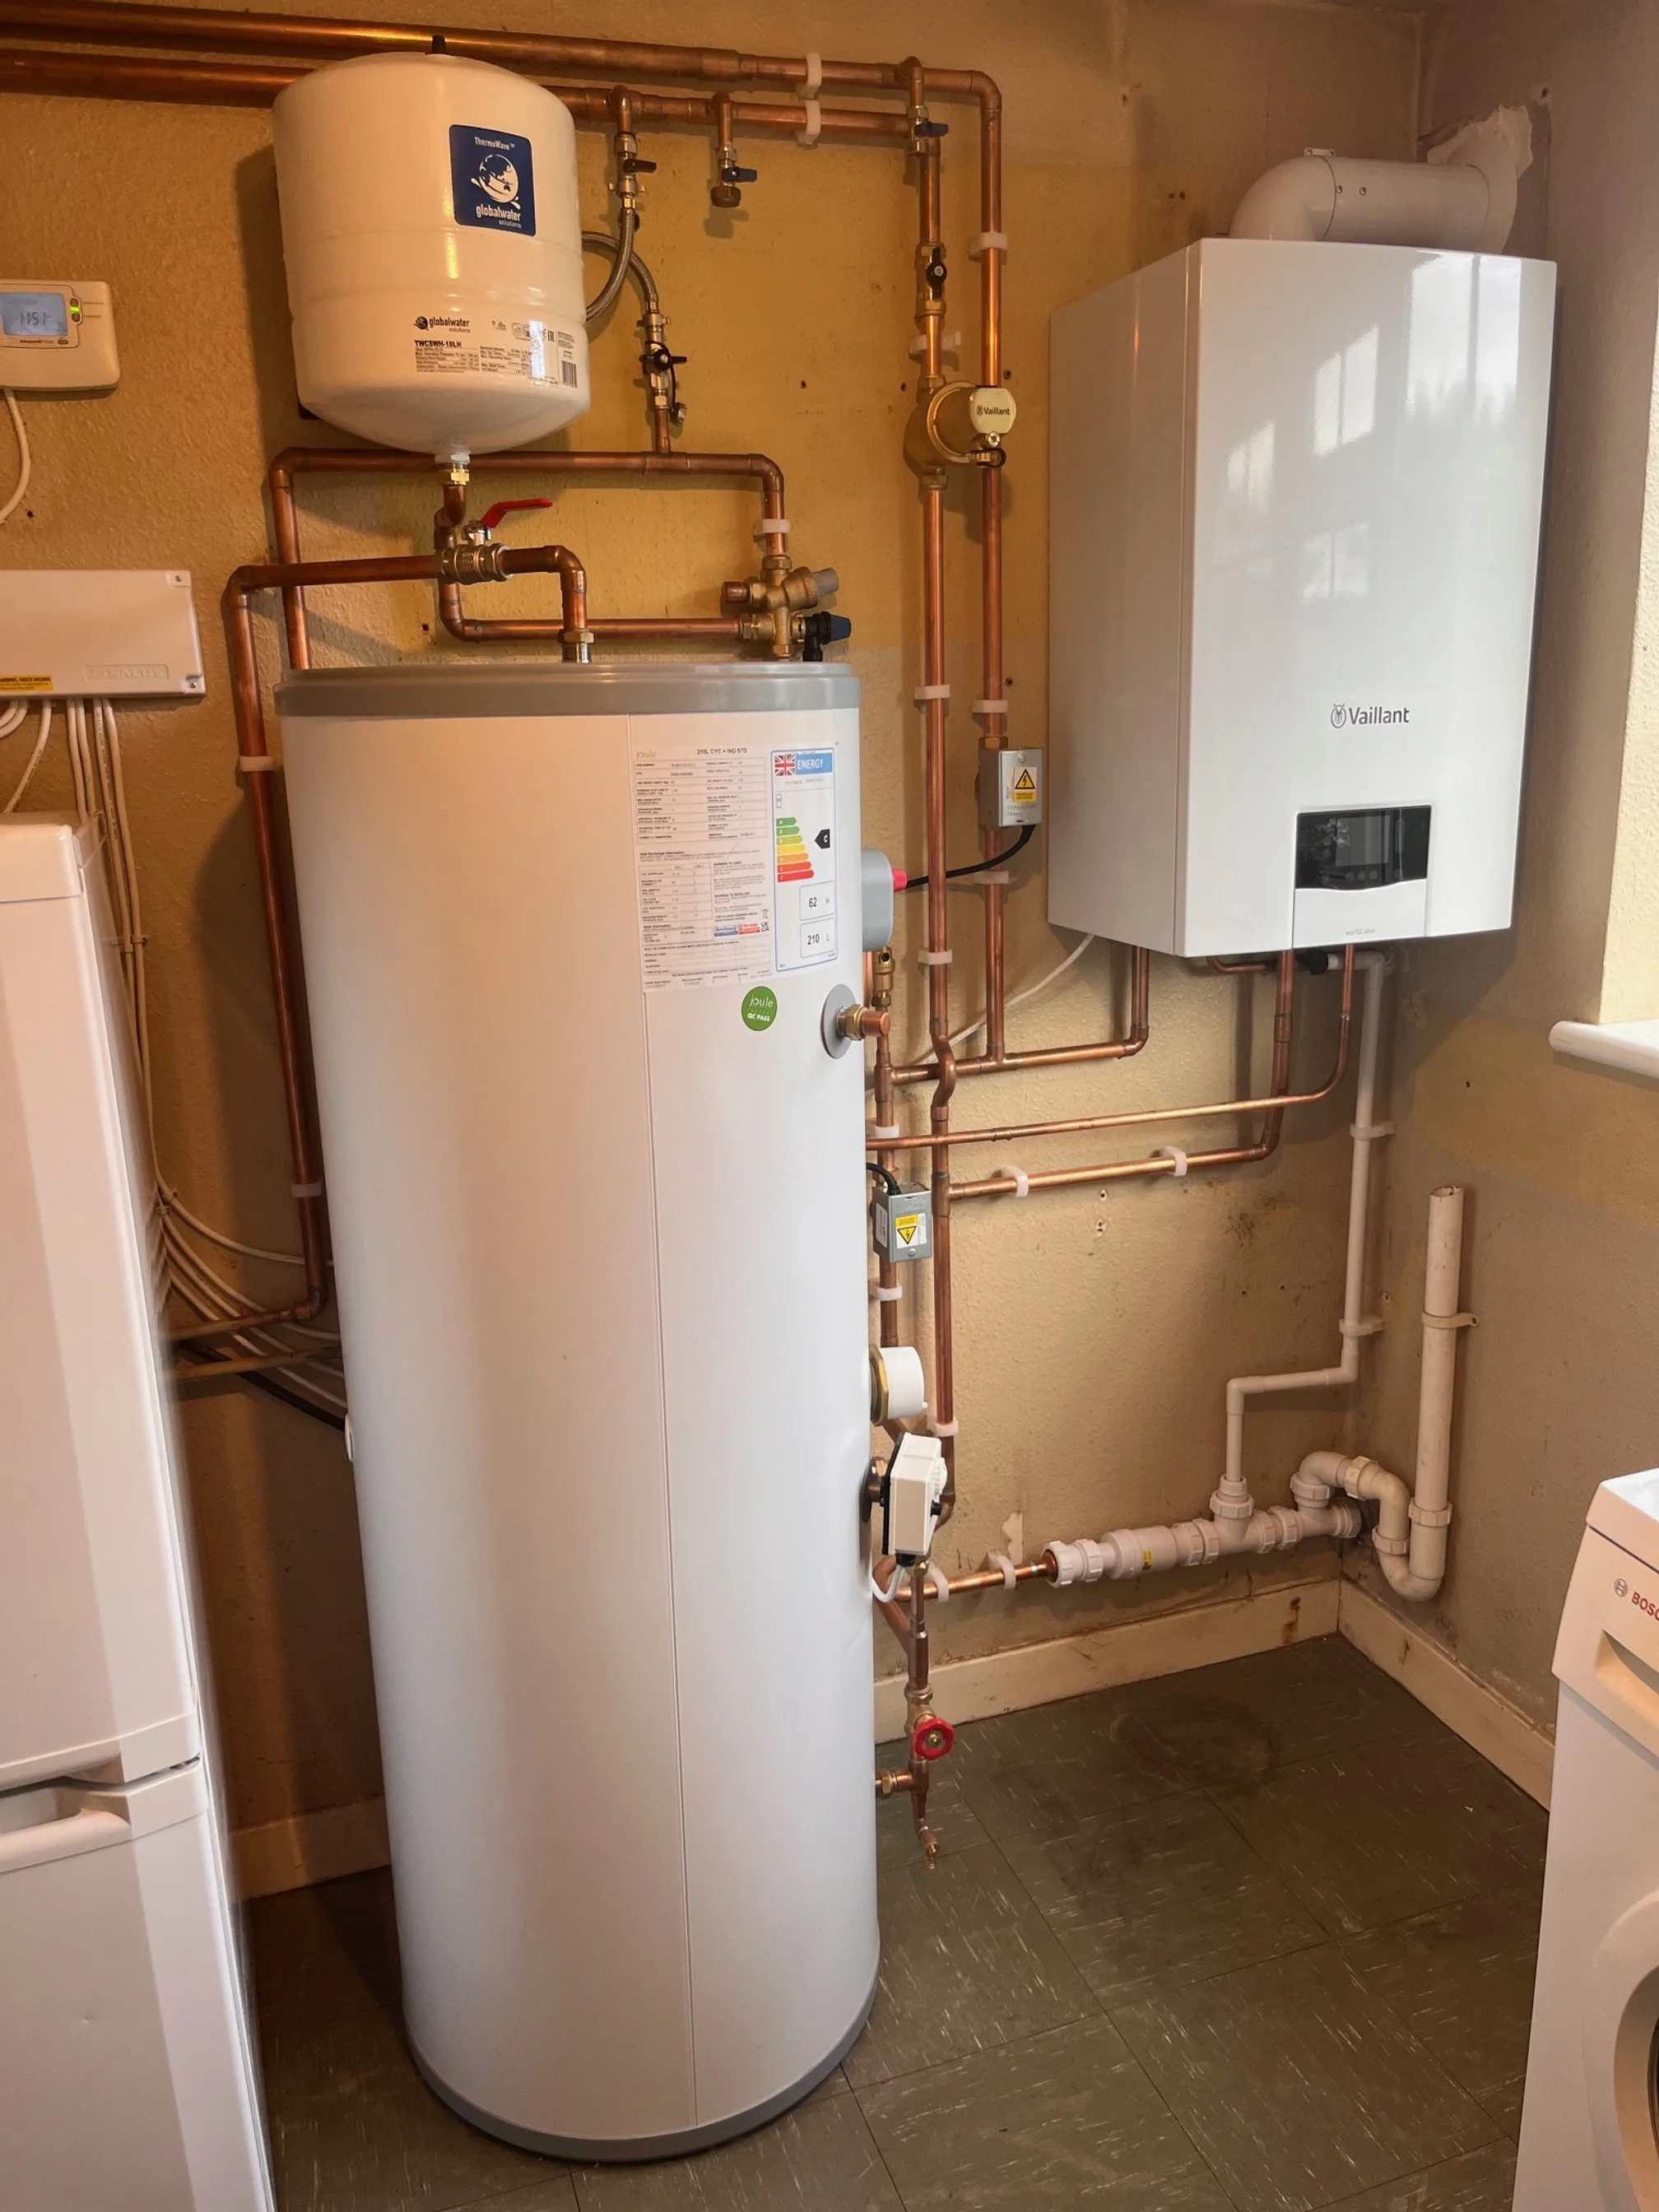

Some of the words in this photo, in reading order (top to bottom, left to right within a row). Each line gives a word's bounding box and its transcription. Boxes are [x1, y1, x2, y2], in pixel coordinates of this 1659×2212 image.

[476, 203, 521, 221] globalwater
[429, 317, 469, 328] globalwater
[983, 407, 1011, 416] Vaillant
[1348, 706, 1410, 725] Vaillant
[797, 759, 824, 770] ENERGY
[808, 897, 817, 908] 62
[807, 933, 820, 945] 210
[749, 994, 774, 1007] joule
